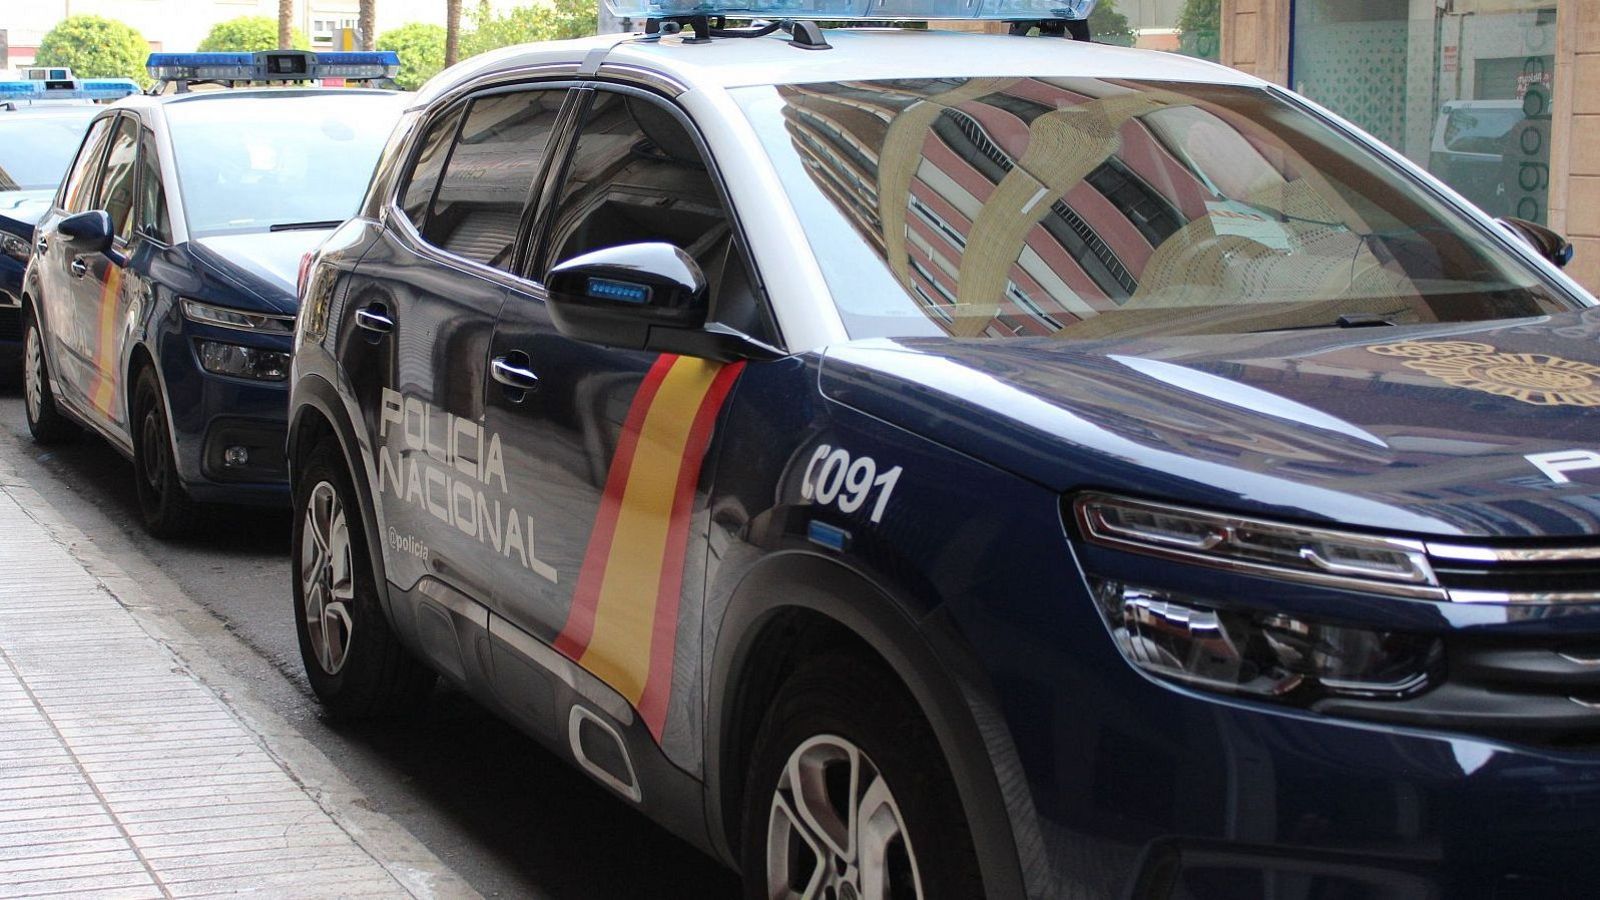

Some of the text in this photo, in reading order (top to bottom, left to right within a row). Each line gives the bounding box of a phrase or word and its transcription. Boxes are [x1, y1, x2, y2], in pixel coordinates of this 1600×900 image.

[380, 387, 508, 494] POLICÍA
[379, 446, 559, 585] NACIONAL
[388, 526, 429, 561] @policia
